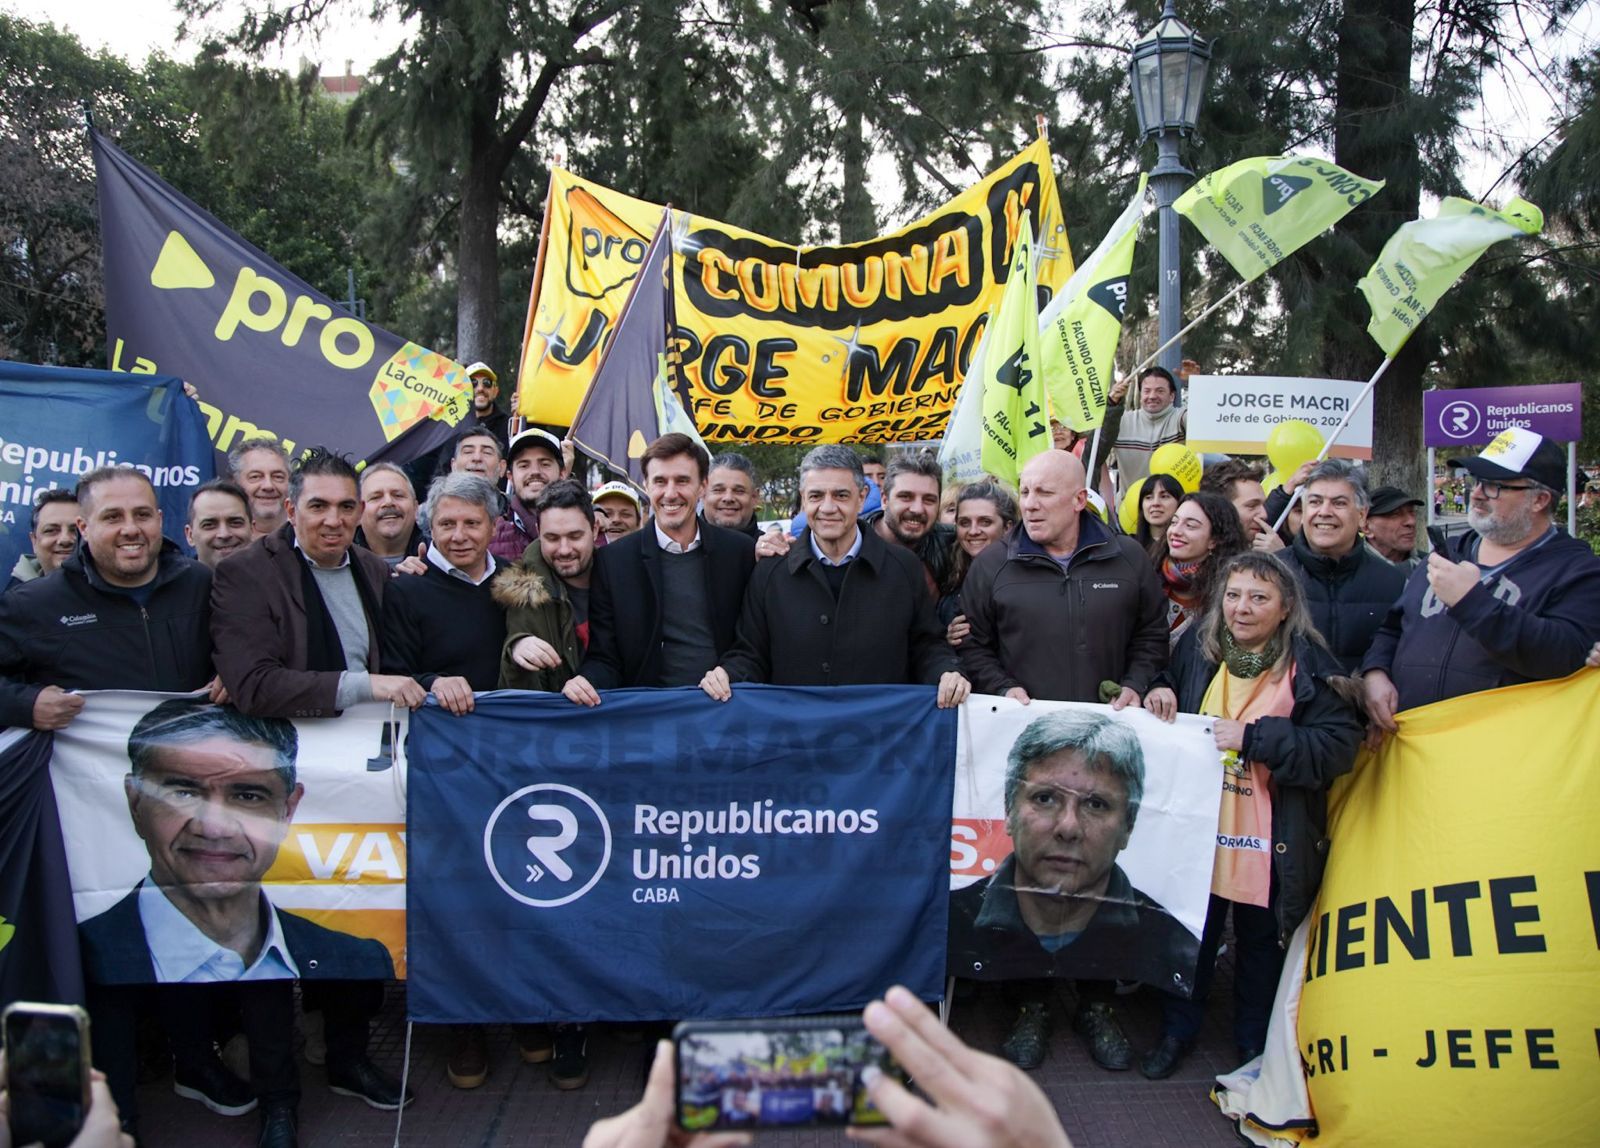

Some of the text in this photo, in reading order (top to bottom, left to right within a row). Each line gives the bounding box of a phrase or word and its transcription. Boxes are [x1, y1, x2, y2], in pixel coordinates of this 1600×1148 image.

[581, 227, 650, 271] pro
[697, 226, 971, 313] COMUNA
[214, 266, 375, 370] pro
[1057, 318, 1094, 422] Secretario General
[1071, 320, 1106, 408] FACUNDO GUZZINI
[758, 402, 798, 419] DE
[1216, 413, 1242, 423] Jefe
[1245, 413, 1259, 423] de
[1217, 393, 1350, 411] JORGE MACRI
[1487, 402, 1574, 418] Republicanos
[1487, 417, 1532, 430] Unidos
[634, 799, 879, 842] Republicanos
[633, 844, 761, 882] Unidos
[632, 888, 681, 904] CABA
[1415, 1029, 1560, 1070] JEFE
